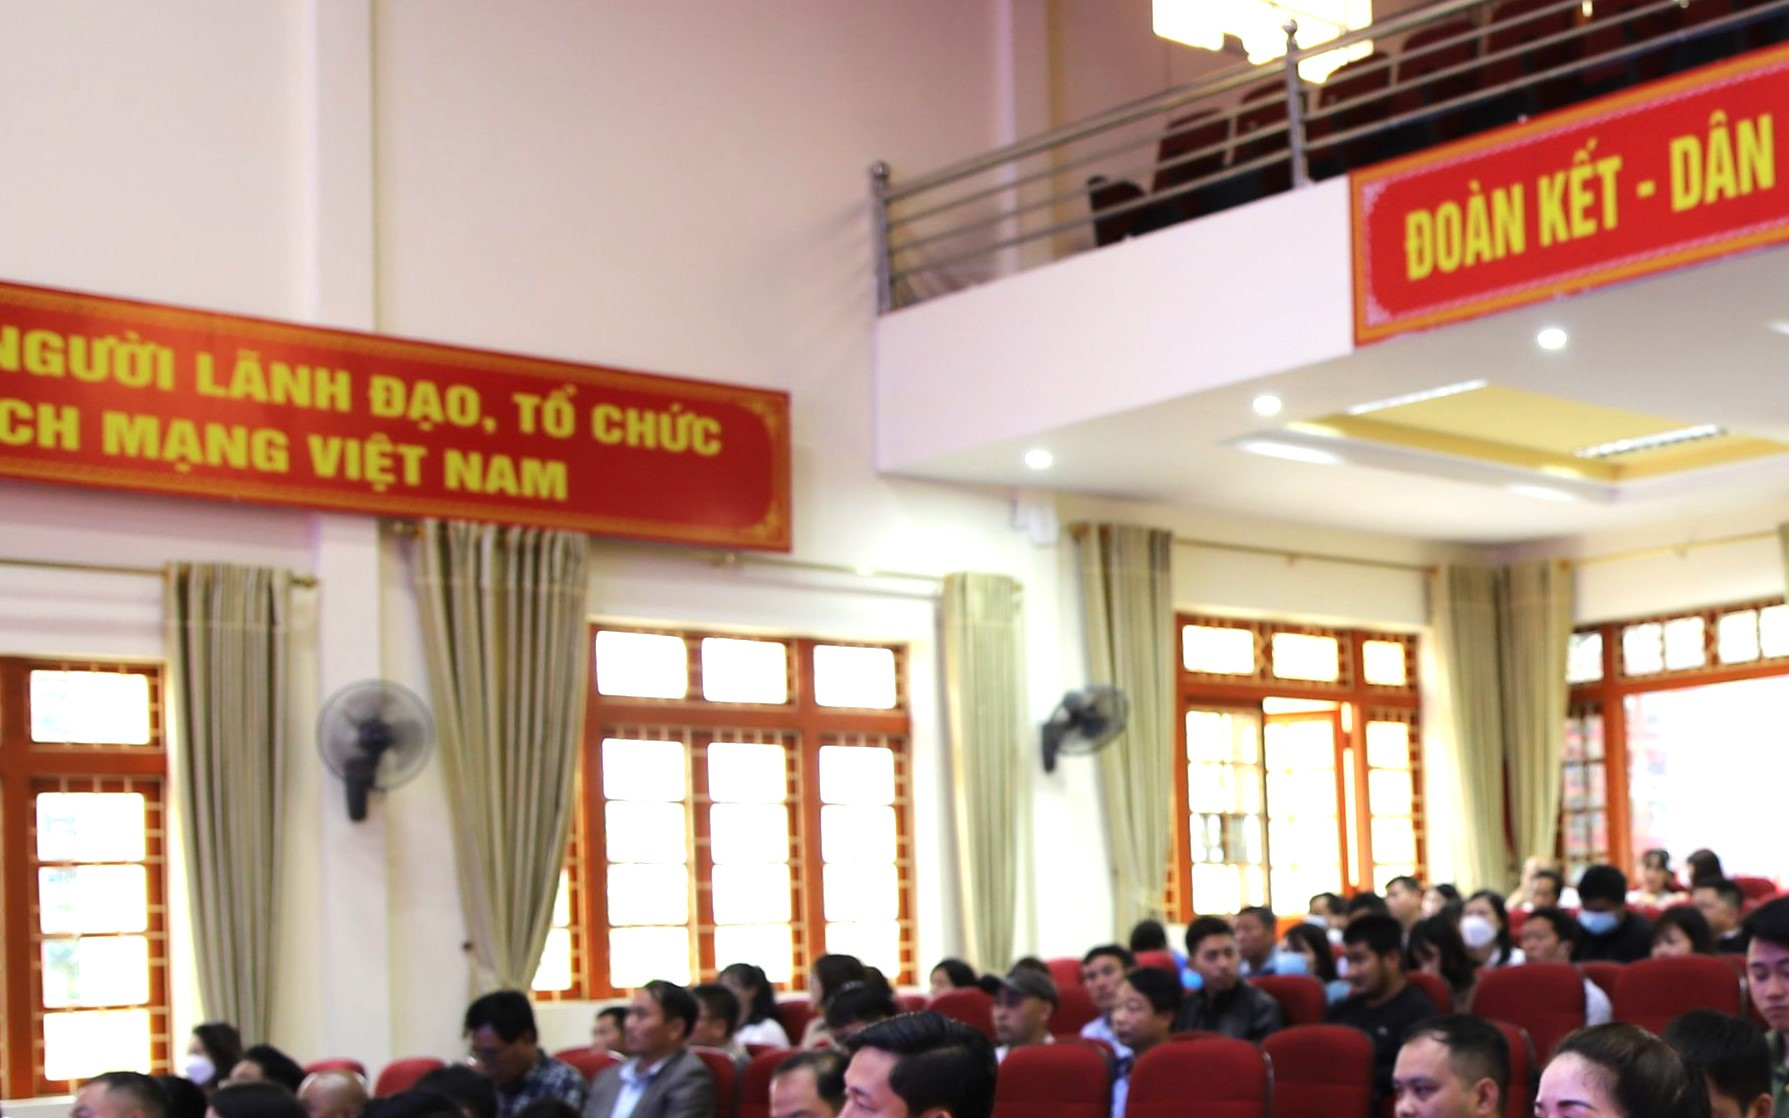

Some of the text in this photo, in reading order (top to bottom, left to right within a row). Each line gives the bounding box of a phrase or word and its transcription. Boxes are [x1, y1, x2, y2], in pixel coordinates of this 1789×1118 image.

[1405, 179, 1526, 281] ĐOÀN
[1538, 138, 1623, 247] KẾT
[1670, 111, 1775, 211] DÂN
[102, 410, 290, 473] MẠNG
[307, 434, 426, 491] VIỆT
[445, 450, 568, 500] NAM
[195, 348, 351, 412] LÃNH
[369, 375, 496, 433] ĐẠO,
[514, 382, 576, 438] TỔ
[592, 403, 721, 455] CHỨC
